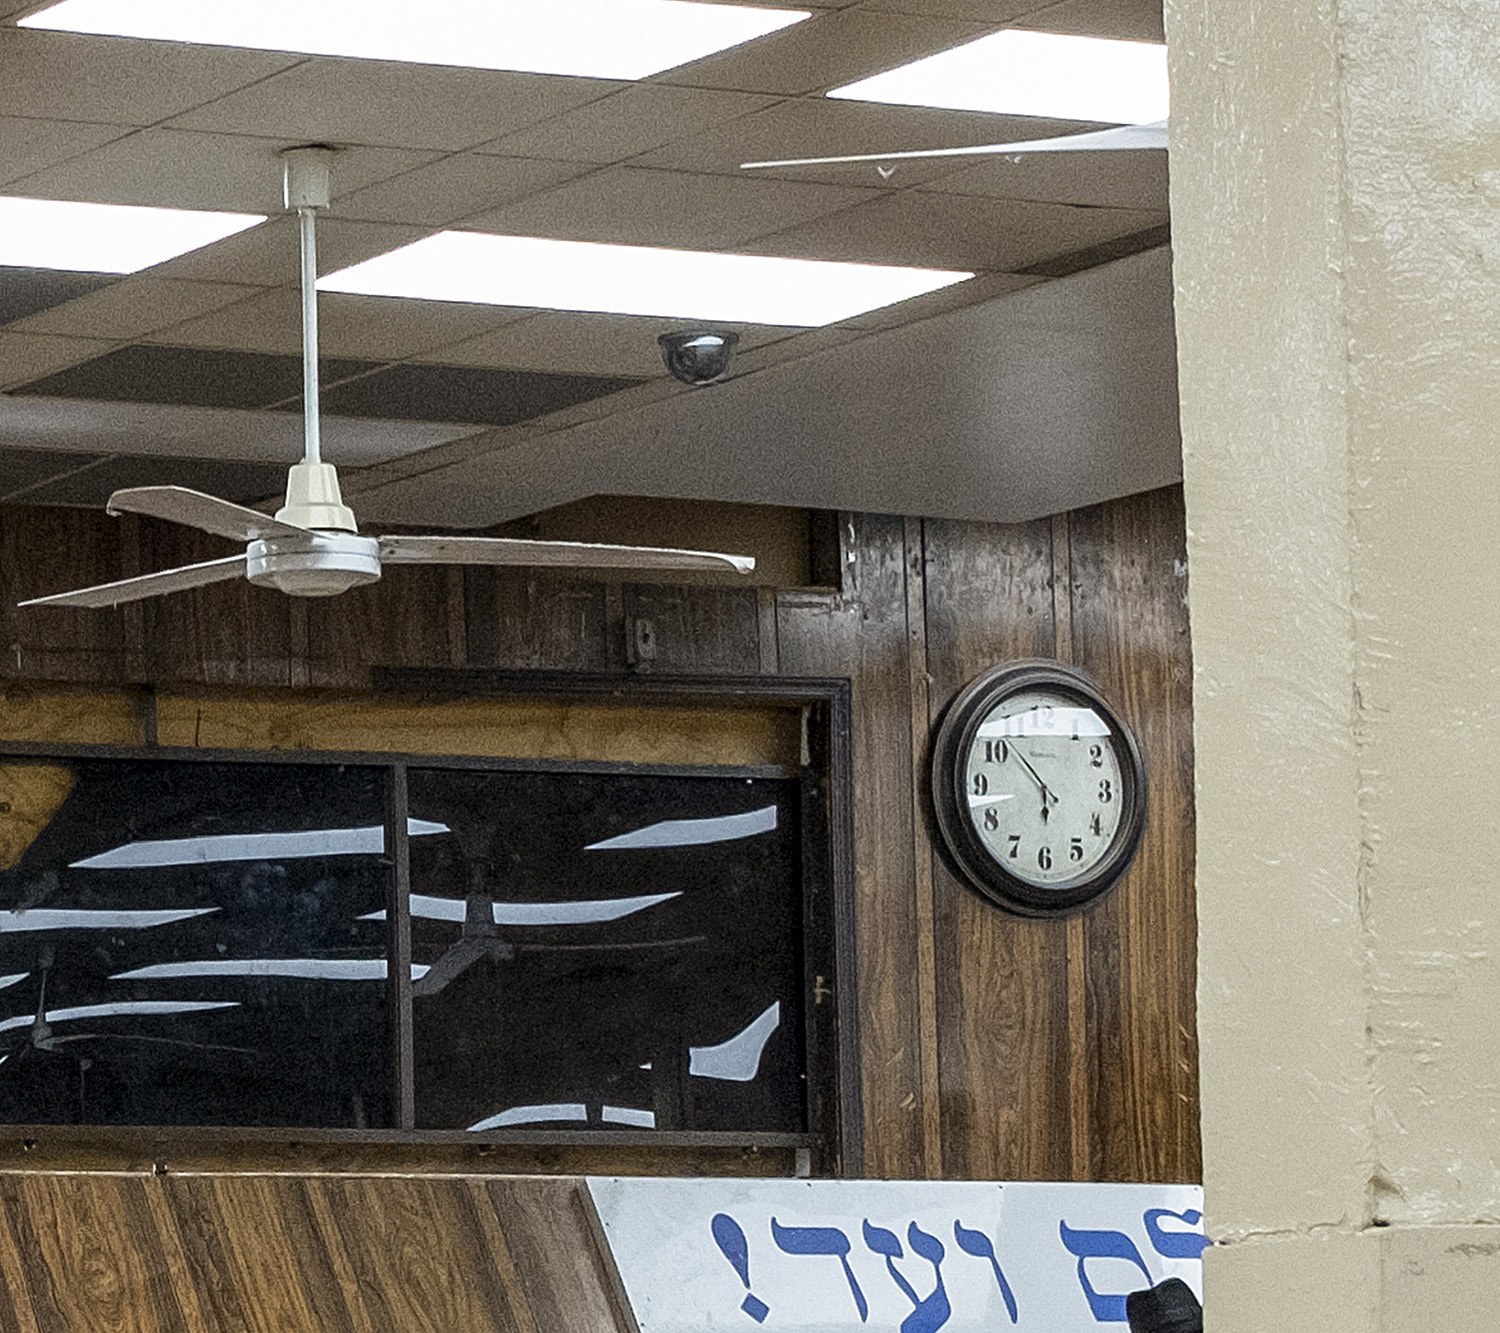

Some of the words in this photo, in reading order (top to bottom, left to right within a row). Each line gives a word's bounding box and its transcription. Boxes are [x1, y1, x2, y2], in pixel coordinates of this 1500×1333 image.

[984, 740, 1009, 763] 10
[1089, 745, 1102, 768] 2
[973, 773, 988, 796] 9
[1099, 780, 1112, 803] 3
[984, 808, 999, 831] 8
[1089, 812, 1101, 836] 4
[1008, 835, 1021, 858] 7
[1070, 838, 1083, 861] 5
[1038, 847, 1052, 870] 6
